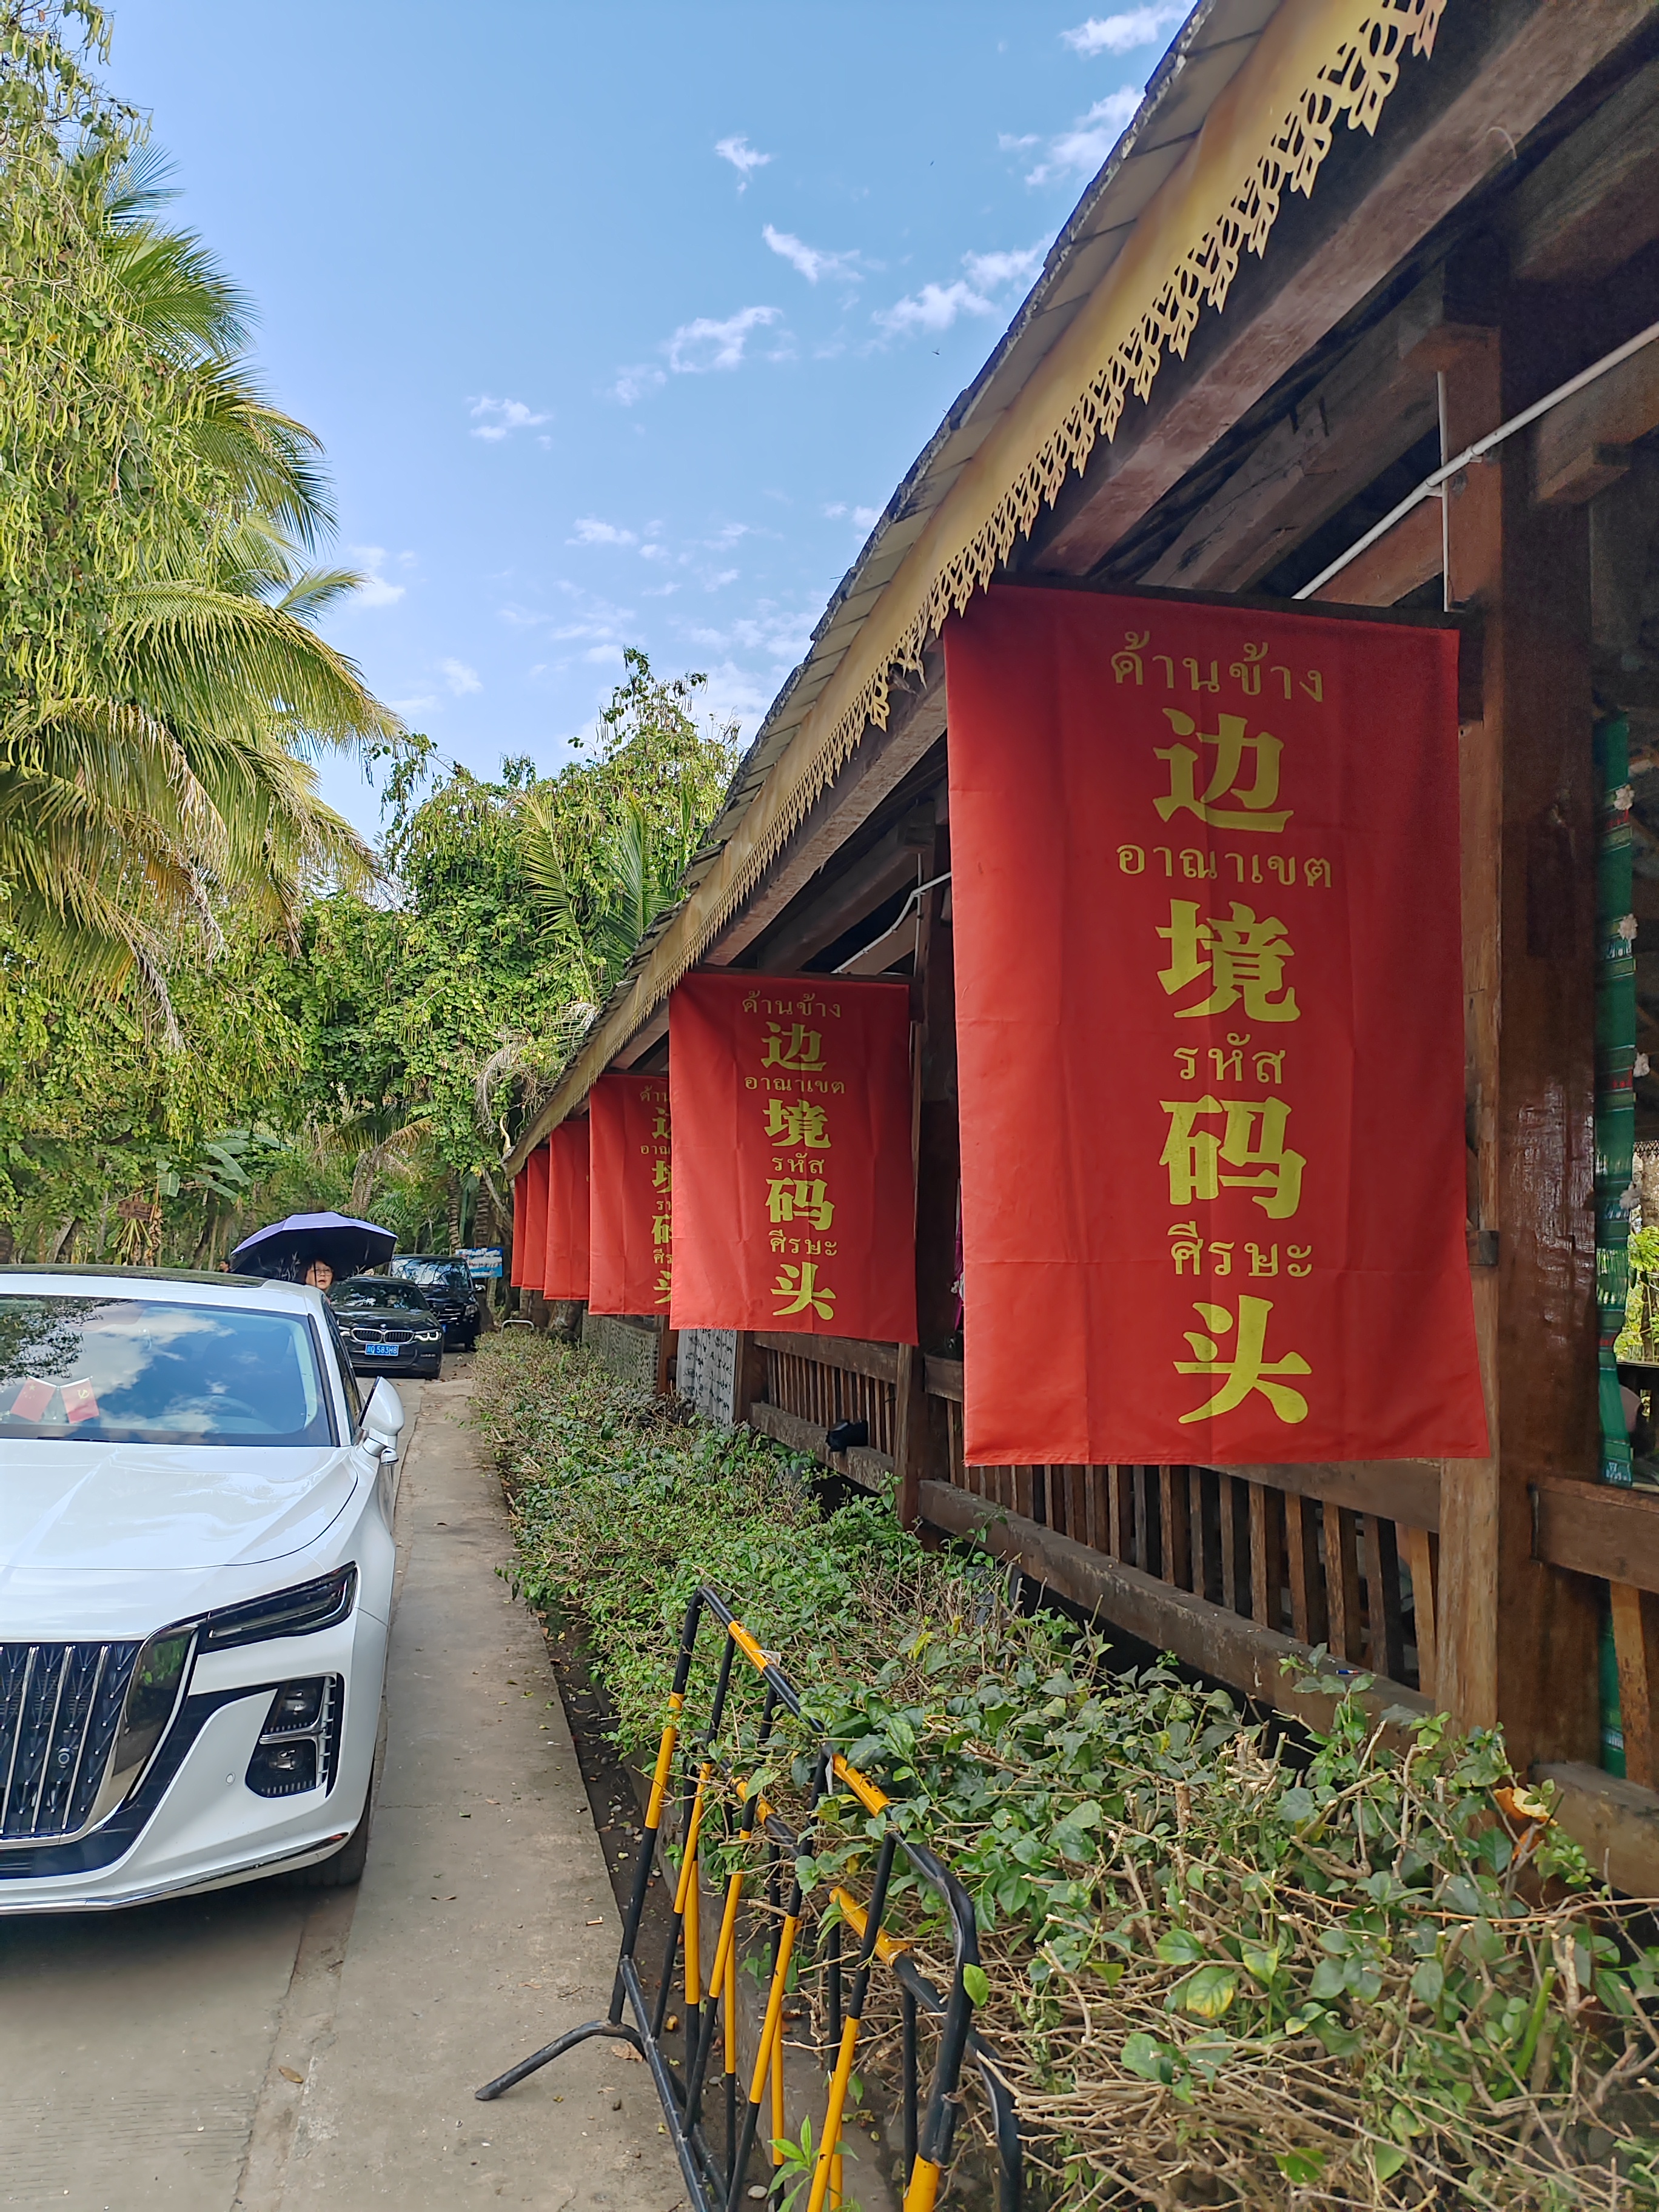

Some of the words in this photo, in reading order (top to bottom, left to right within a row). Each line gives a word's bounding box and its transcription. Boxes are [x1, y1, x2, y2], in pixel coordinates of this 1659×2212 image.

[1111, 631, 1324, 702] ด้านข้าง
[1153, 708, 1294, 833] 边
[1116, 843, 1332, 888] อาณาเขต
[1155, 898, 1302, 1023] 境
[742, 990, 841, 1018] ด้านข้าง
[761, 1021, 826, 1071] 边
[1173, 1032, 1287, 1085] รหัส
[744, 1076, 845, 1094] อาณาเขต
[763, 1098, 832, 1149] 境
[771, 1153, 825, 1175] รหัส
[1159, 1093, 1308, 1219] 码
[765, 1176, 836, 1231] 码
[768, 1230, 838, 1257] ศีรษะ
[1167, 1220, 1313, 1278] ศีรษะ
[770, 1261, 837, 1321] 头
[1173, 1293, 1314, 1425] 头
